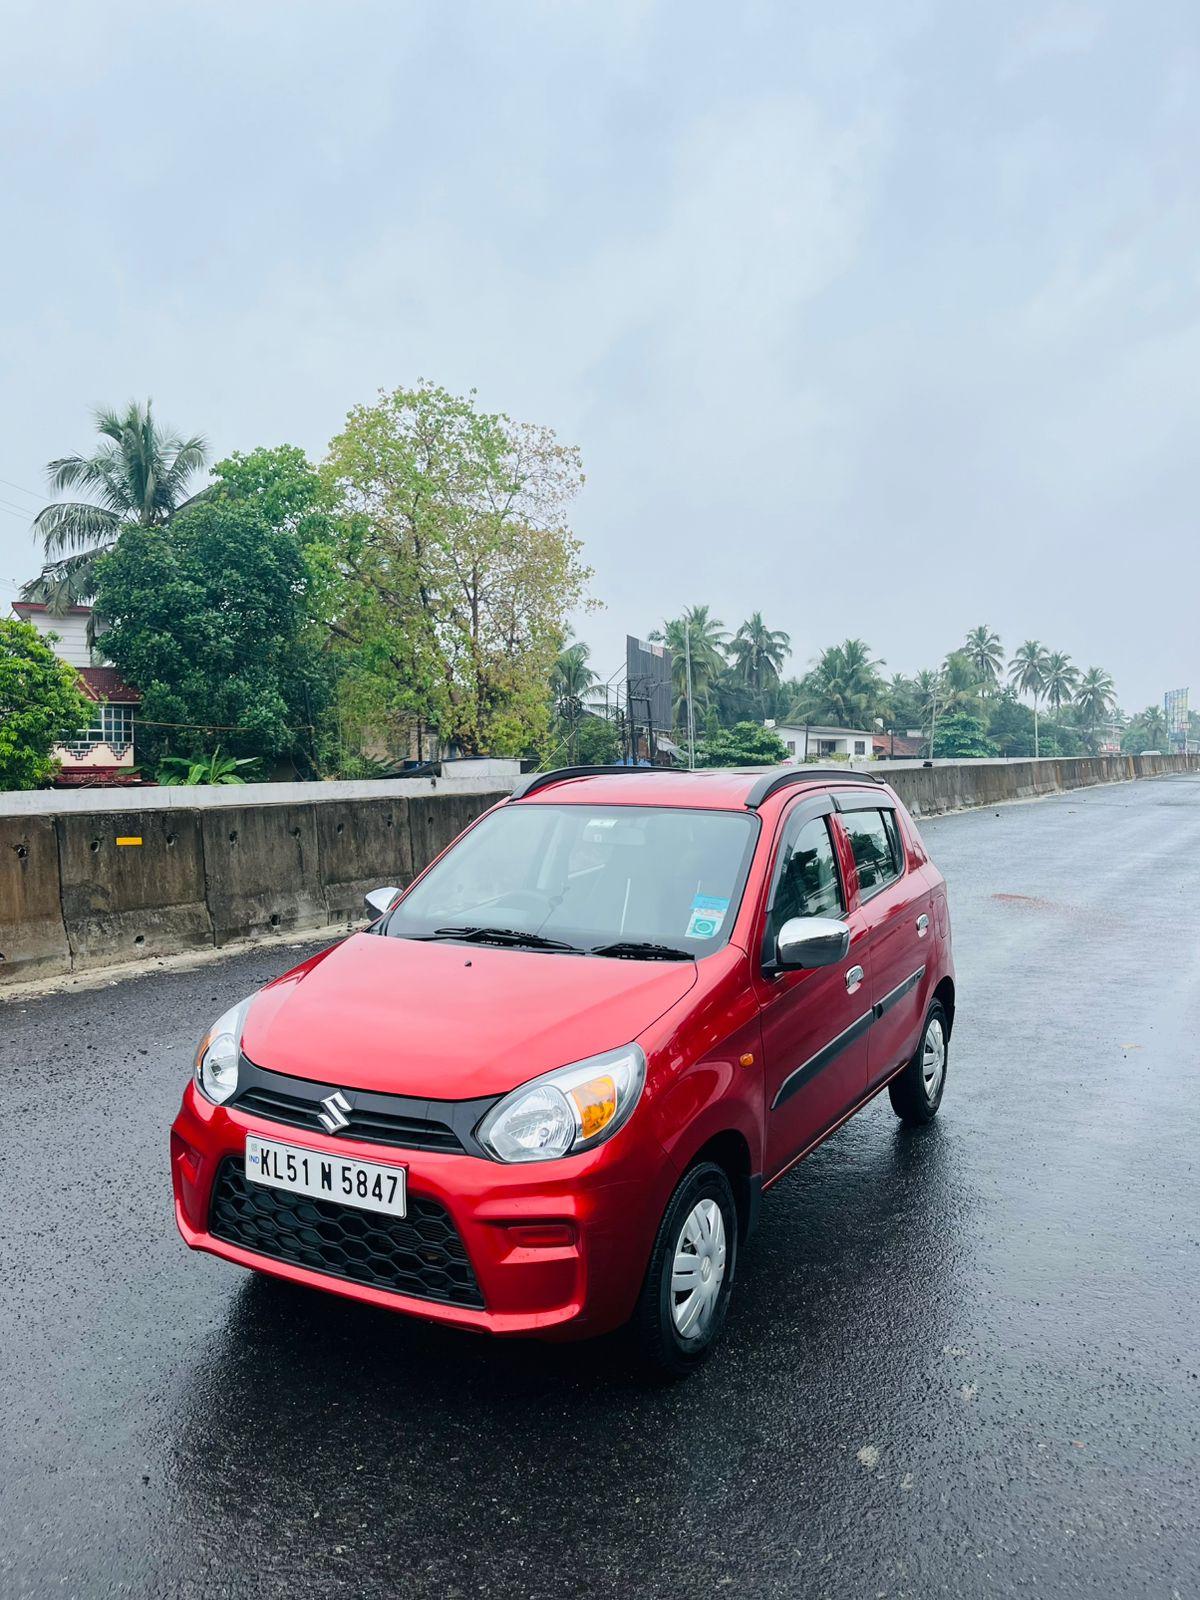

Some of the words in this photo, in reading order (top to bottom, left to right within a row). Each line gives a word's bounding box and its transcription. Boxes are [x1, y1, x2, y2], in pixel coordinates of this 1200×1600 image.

[260, 1148, 309, 1186] KL51
[320, 1161, 332, 1191] N
[341, 1166, 398, 1204] 5847
